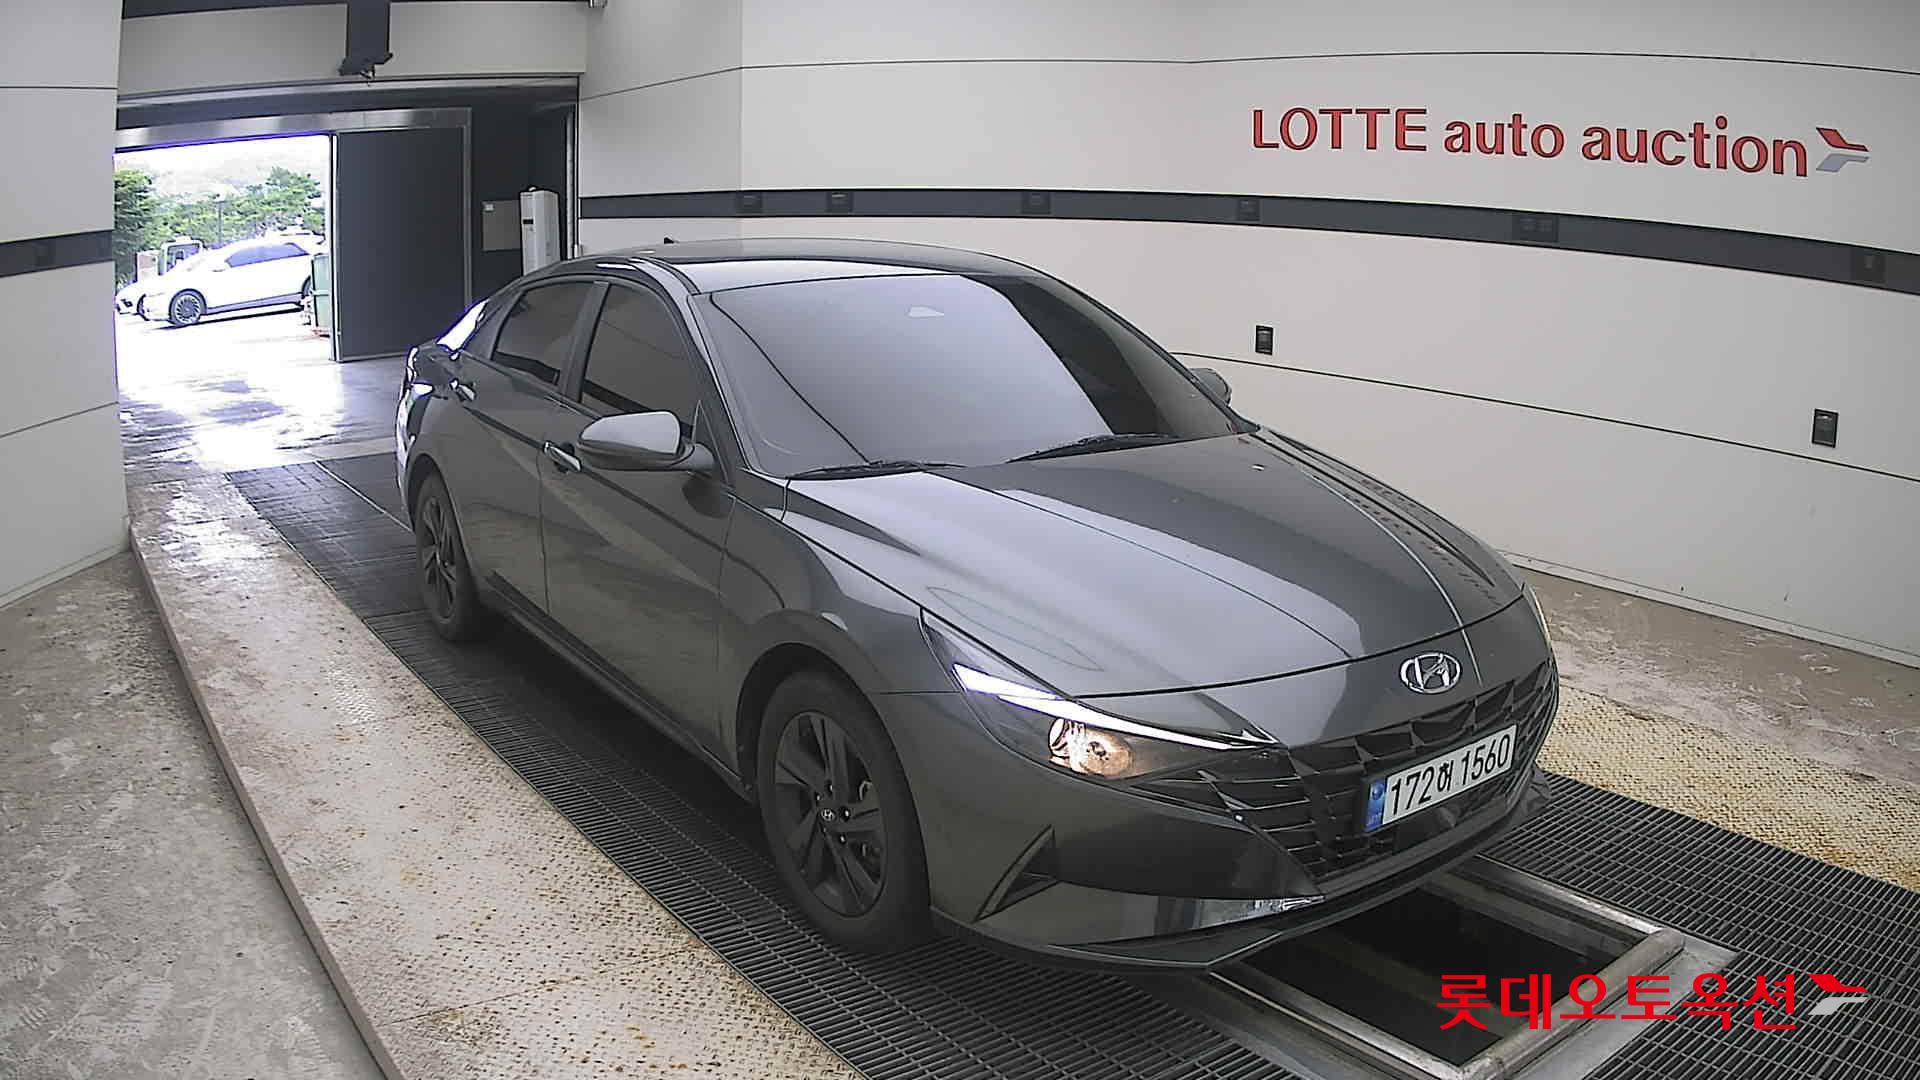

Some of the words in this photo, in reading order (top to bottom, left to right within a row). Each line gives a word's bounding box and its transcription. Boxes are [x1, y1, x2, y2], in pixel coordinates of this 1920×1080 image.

[1252, 108, 1427, 152] LOTTE
[1444, 113, 1565, 158] auto
[1581, 115, 1809, 177] auction
[1391, 760, 1454, 816] 172허
[1461, 734, 1511, 786] 1560
